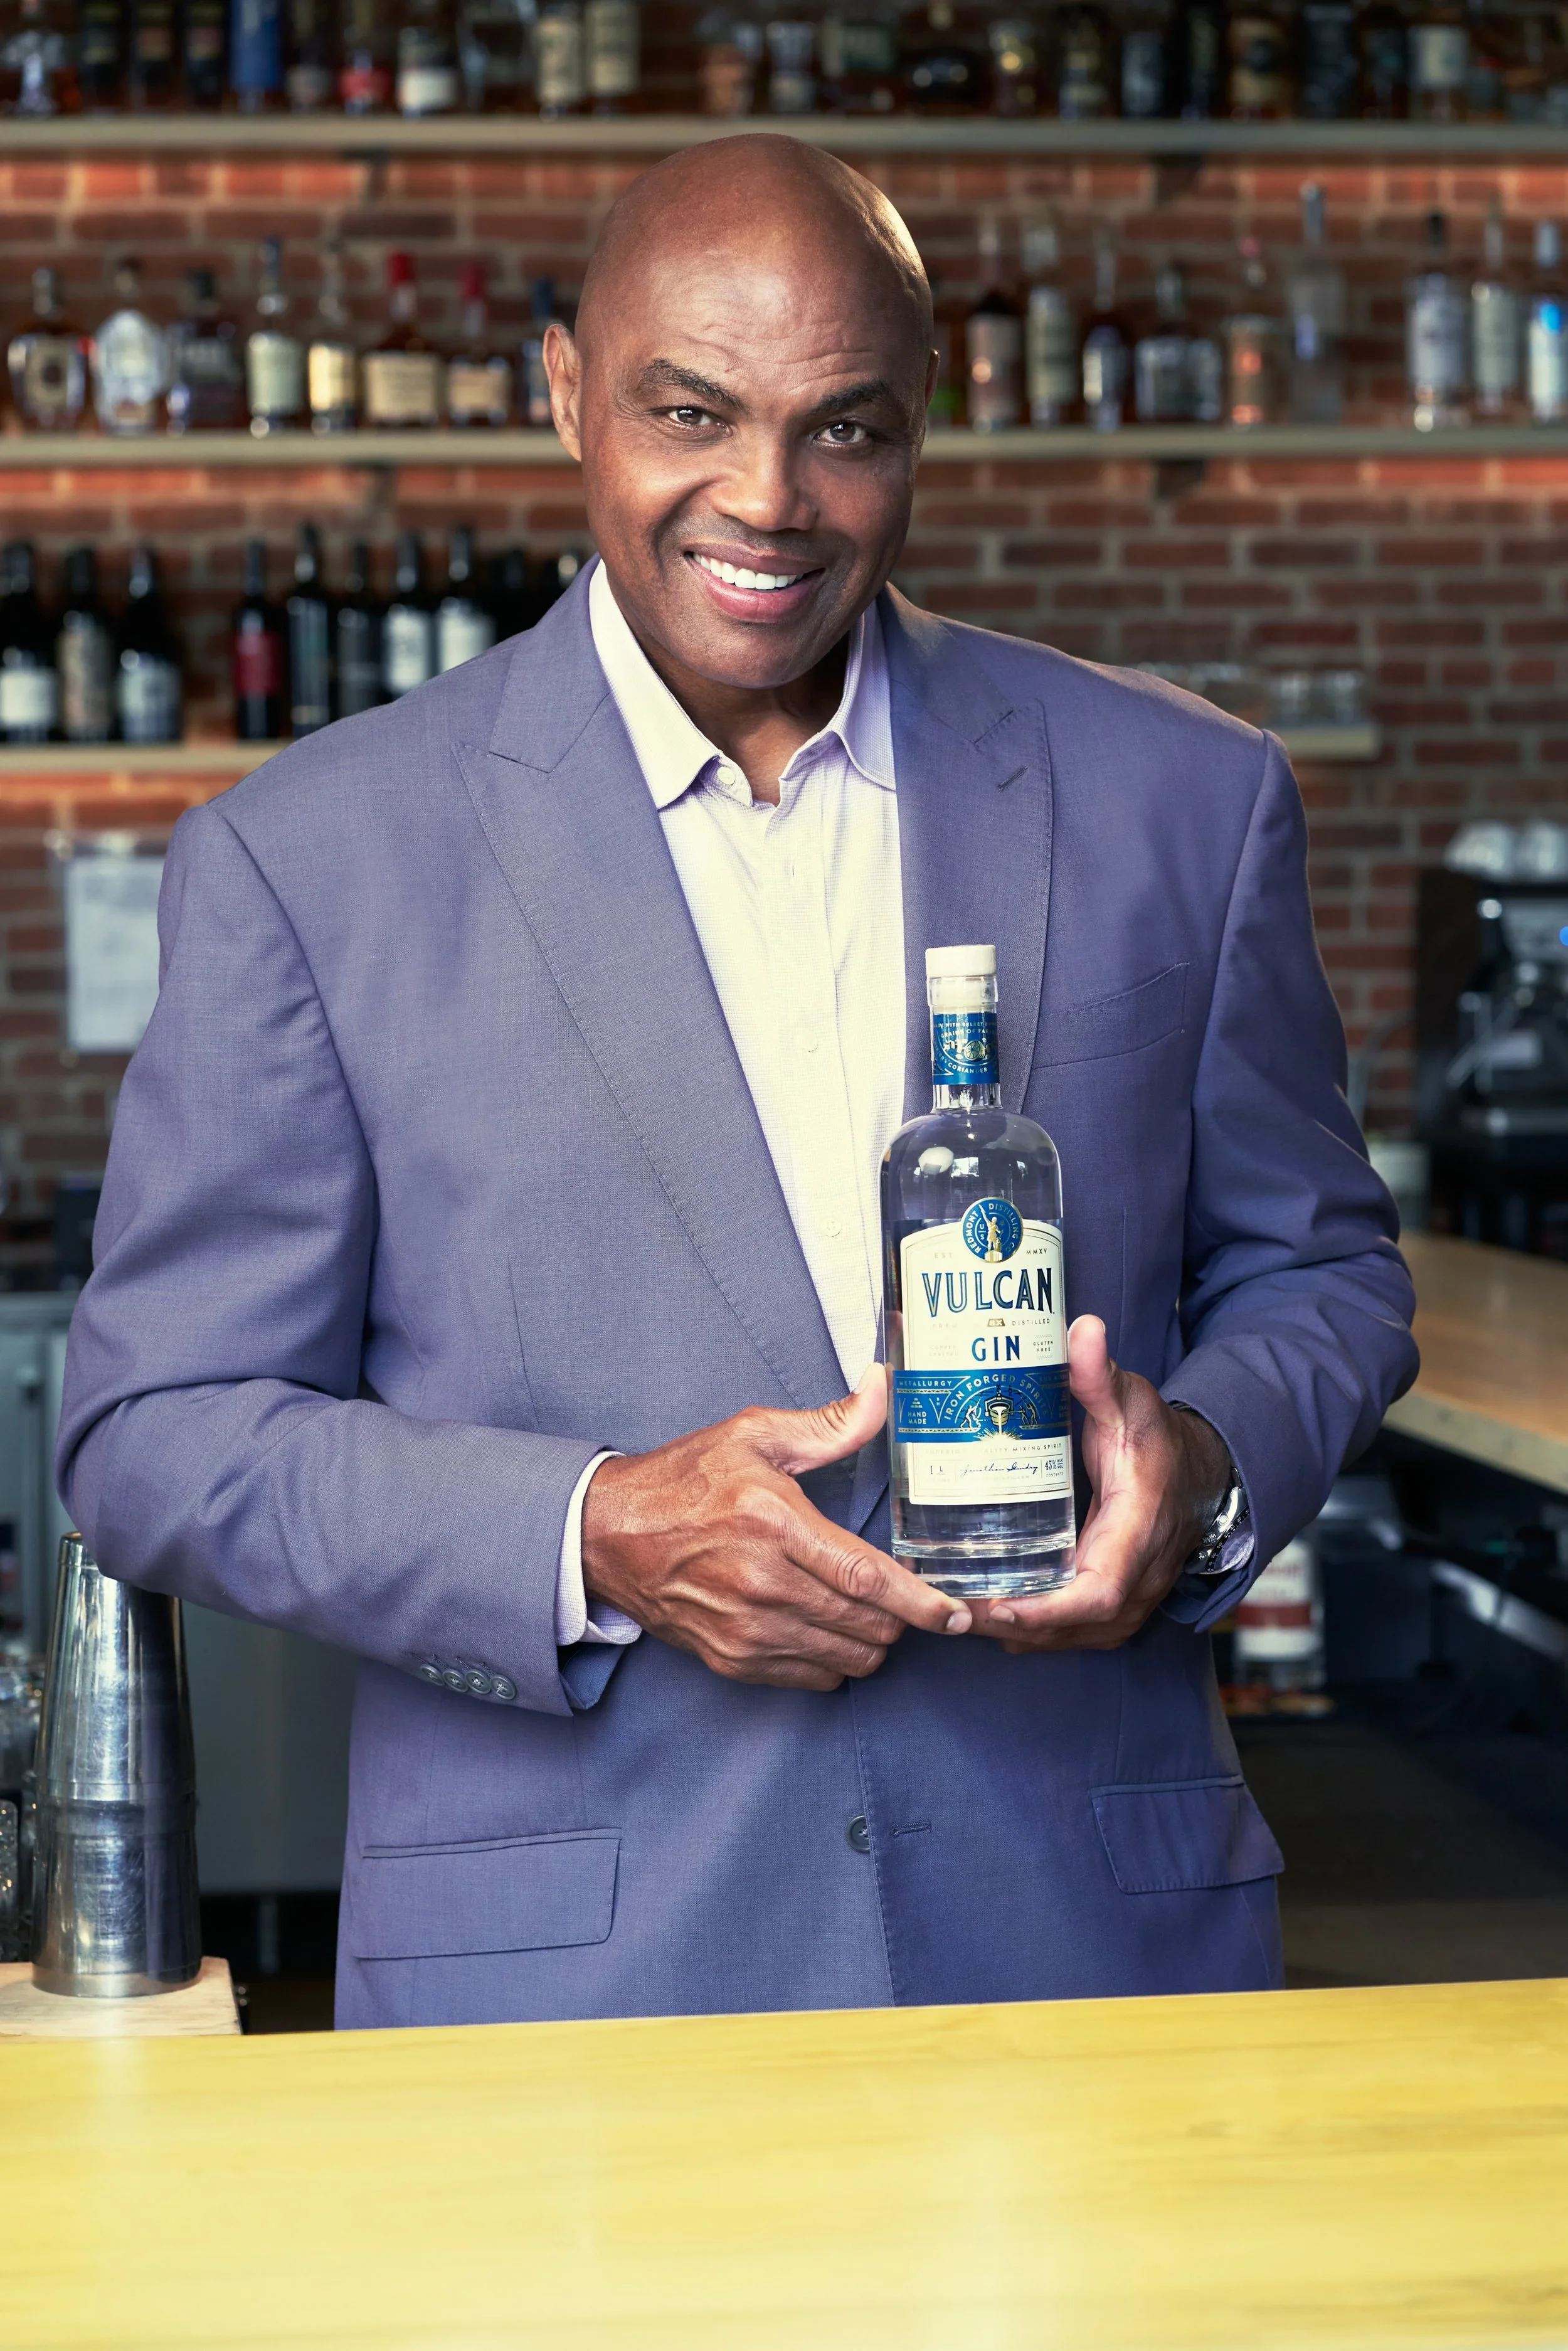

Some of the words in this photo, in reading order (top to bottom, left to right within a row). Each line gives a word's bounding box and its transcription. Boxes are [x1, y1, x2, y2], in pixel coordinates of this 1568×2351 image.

[948, 1062, 988, 1074] CORIANDER
[966, 1210, 982, 1254] REDMONT
[988, 1203, 1019, 1239] DISTILLING
[921, 1268, 1052, 1318] VULCAN
[1012, 1318, 1050, 1326] DISTILLED
[972, 1335, 1020, 1362] GIN
[944, 1391, 965, 1420] IRON
[966, 1374, 1015, 1391] FORGED
[1045, 1459, 1057, 1470] 45%
